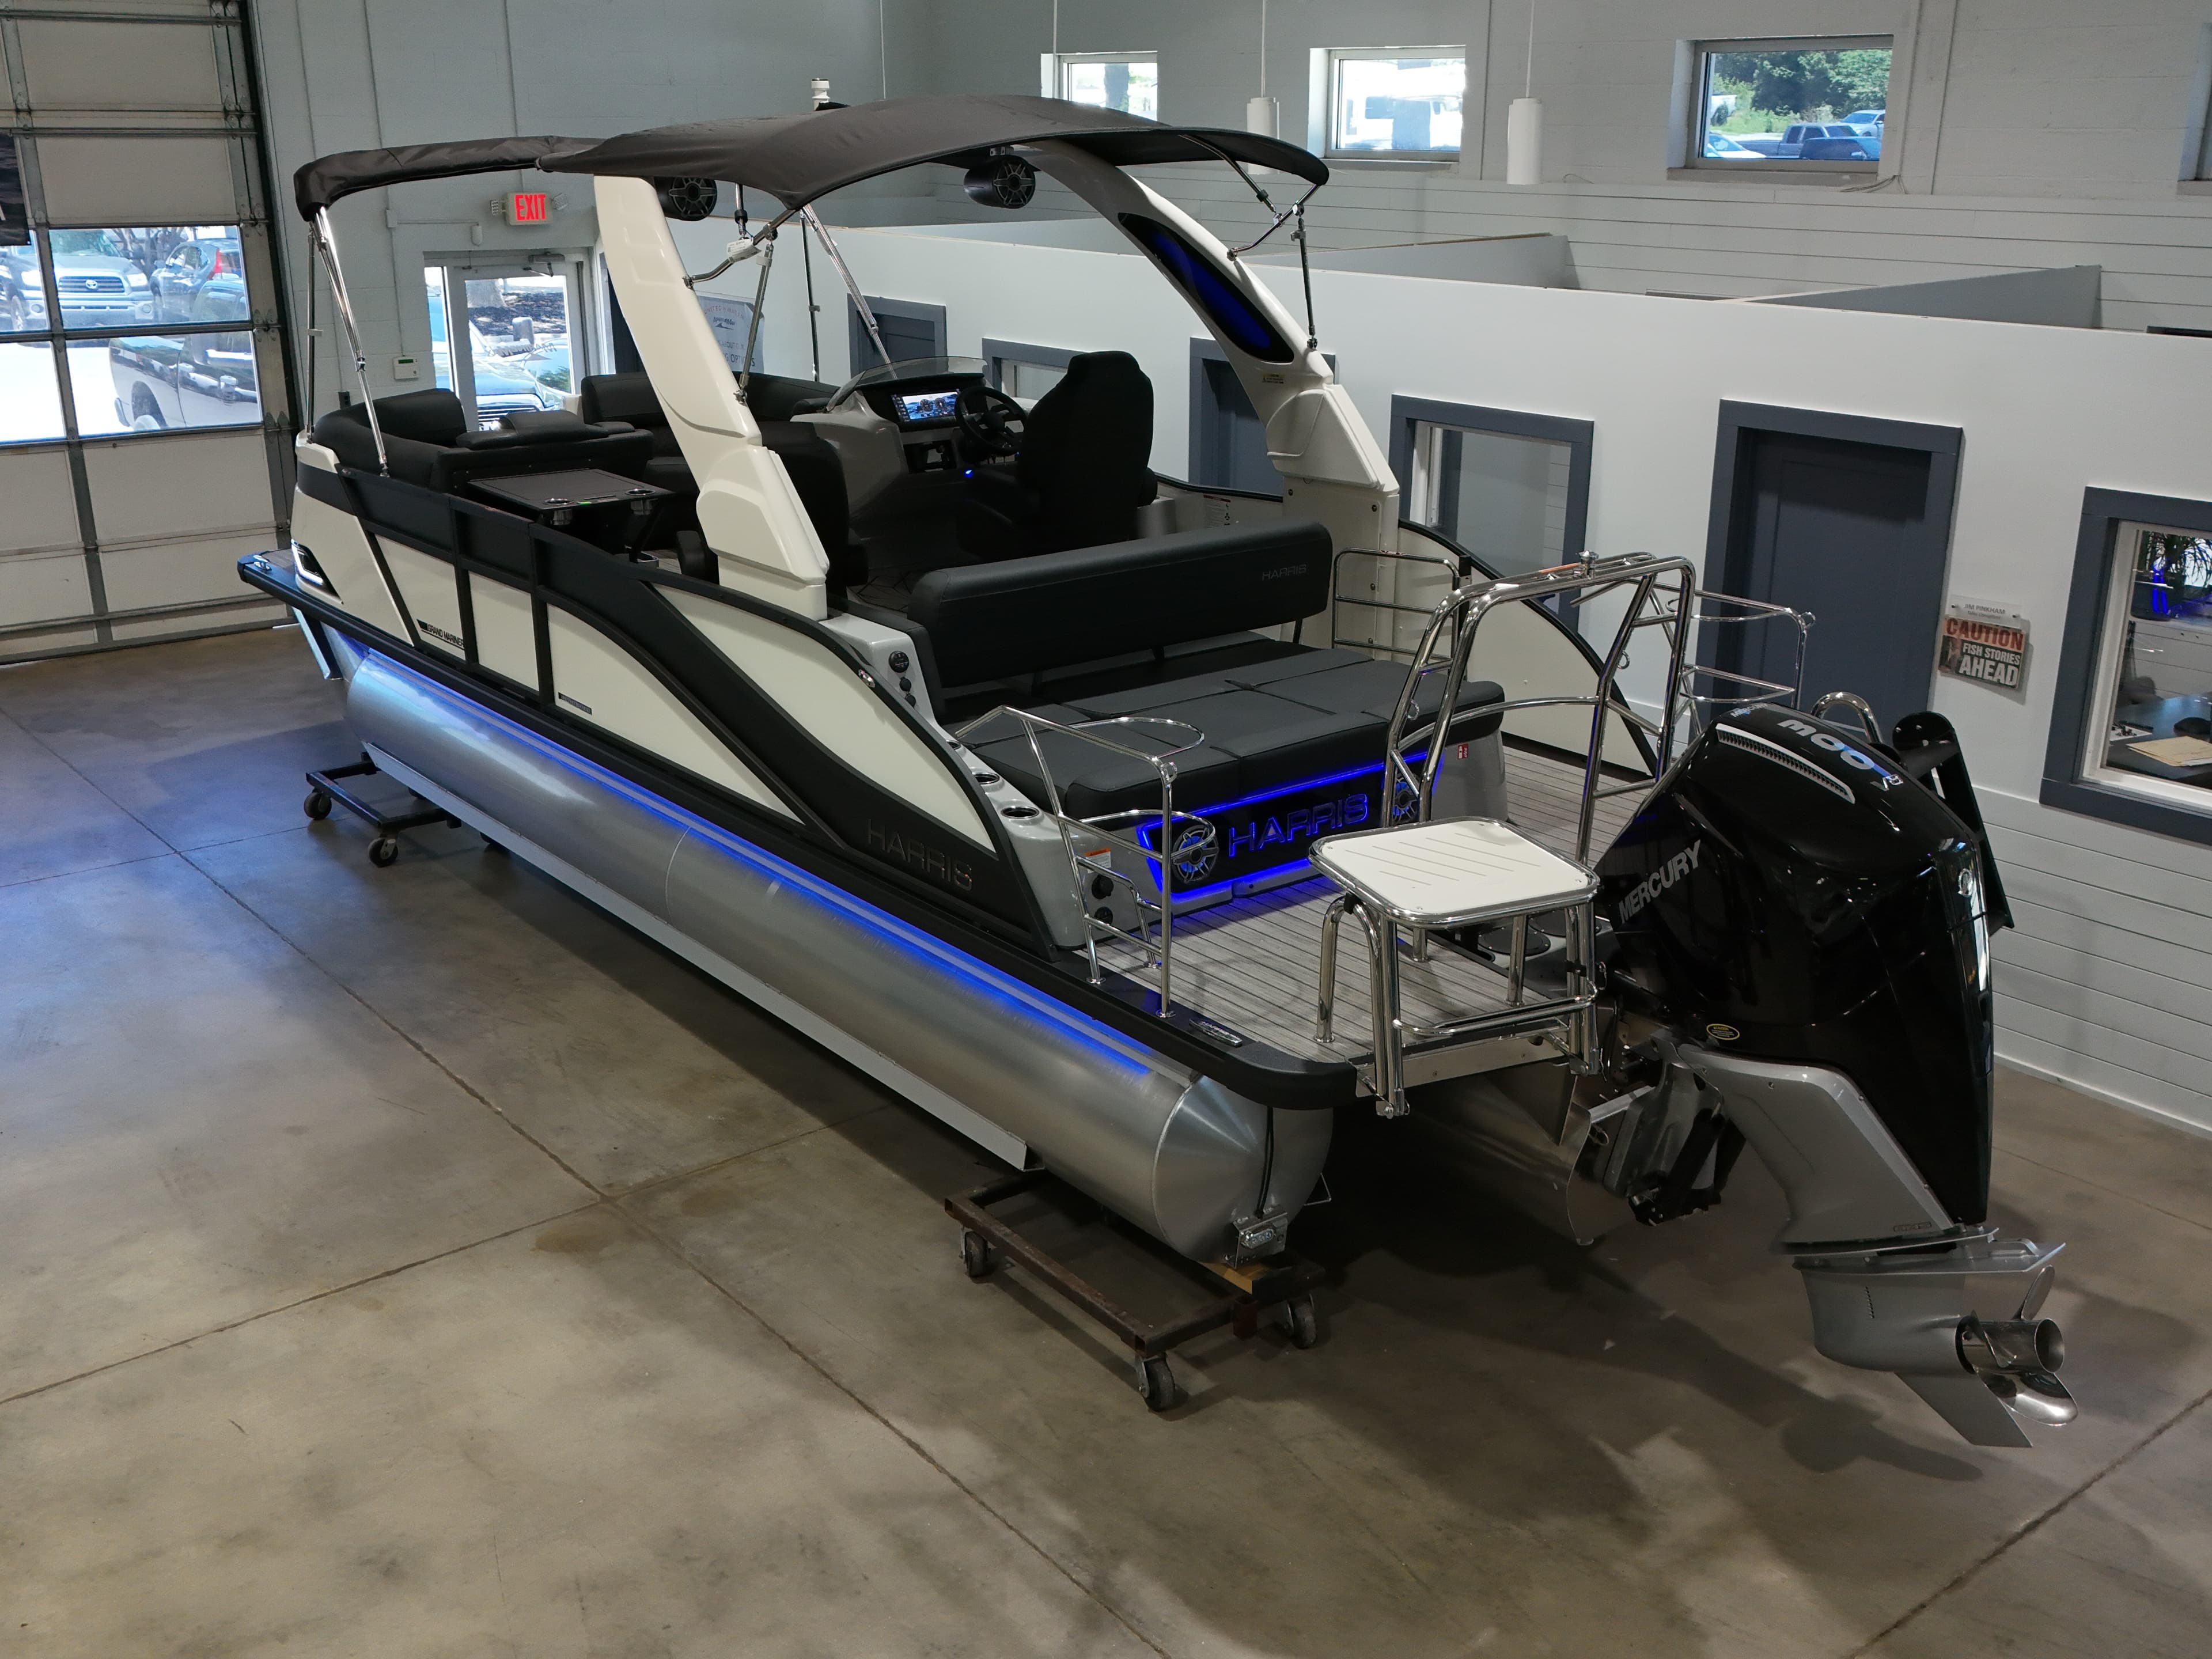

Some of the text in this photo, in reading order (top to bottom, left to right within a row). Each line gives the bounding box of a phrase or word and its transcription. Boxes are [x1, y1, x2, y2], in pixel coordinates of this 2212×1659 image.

[514, 193, 546, 221] EXIT
[1262, 564, 1308, 581] HARRIS
[1976, 605, 2006, 615] PINKHAM
[427, 624, 443, 638] GRAND
[1946, 618, 2024, 651] CAUTION
[1963, 642, 2021, 665] FISH STORIES
[1959, 654, 2019, 686] AHEAD
[1730, 703, 1769, 718] MERCURY
[1228, 793, 1369, 858] HARRIS
[868, 819, 973, 892] HARRIS
[1618, 839, 1701, 925] MERCURY
